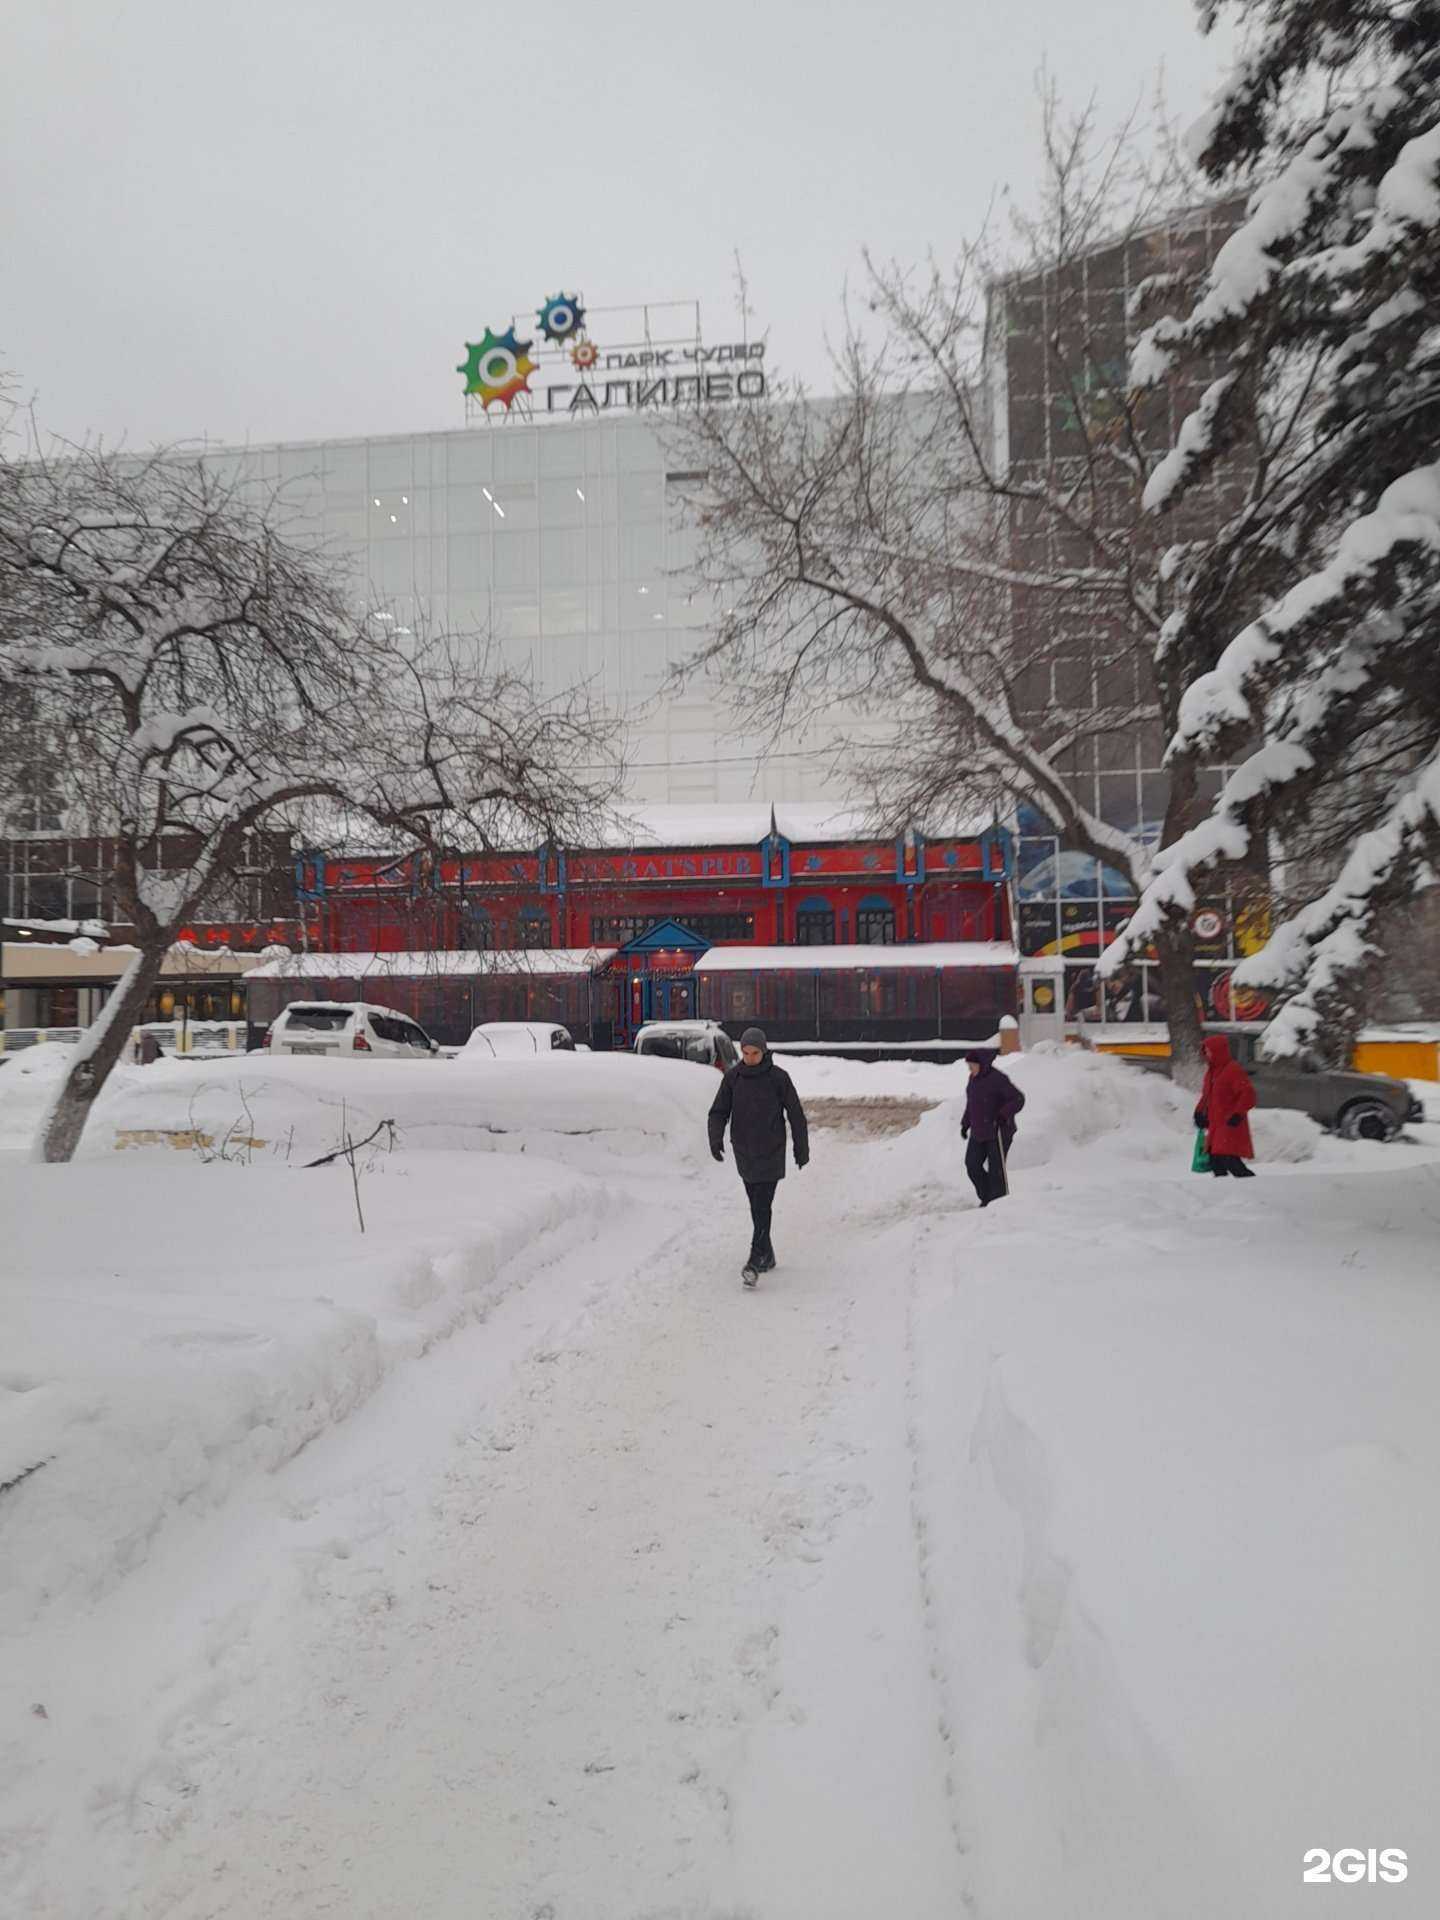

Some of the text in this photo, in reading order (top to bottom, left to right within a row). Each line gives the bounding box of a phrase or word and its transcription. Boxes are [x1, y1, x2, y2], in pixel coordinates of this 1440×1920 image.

[606, 350, 673, 369] ПАРК
[547, 370, 765, 411] ГАЛИЛЕО
[703, 856, 751, 875] PUB
